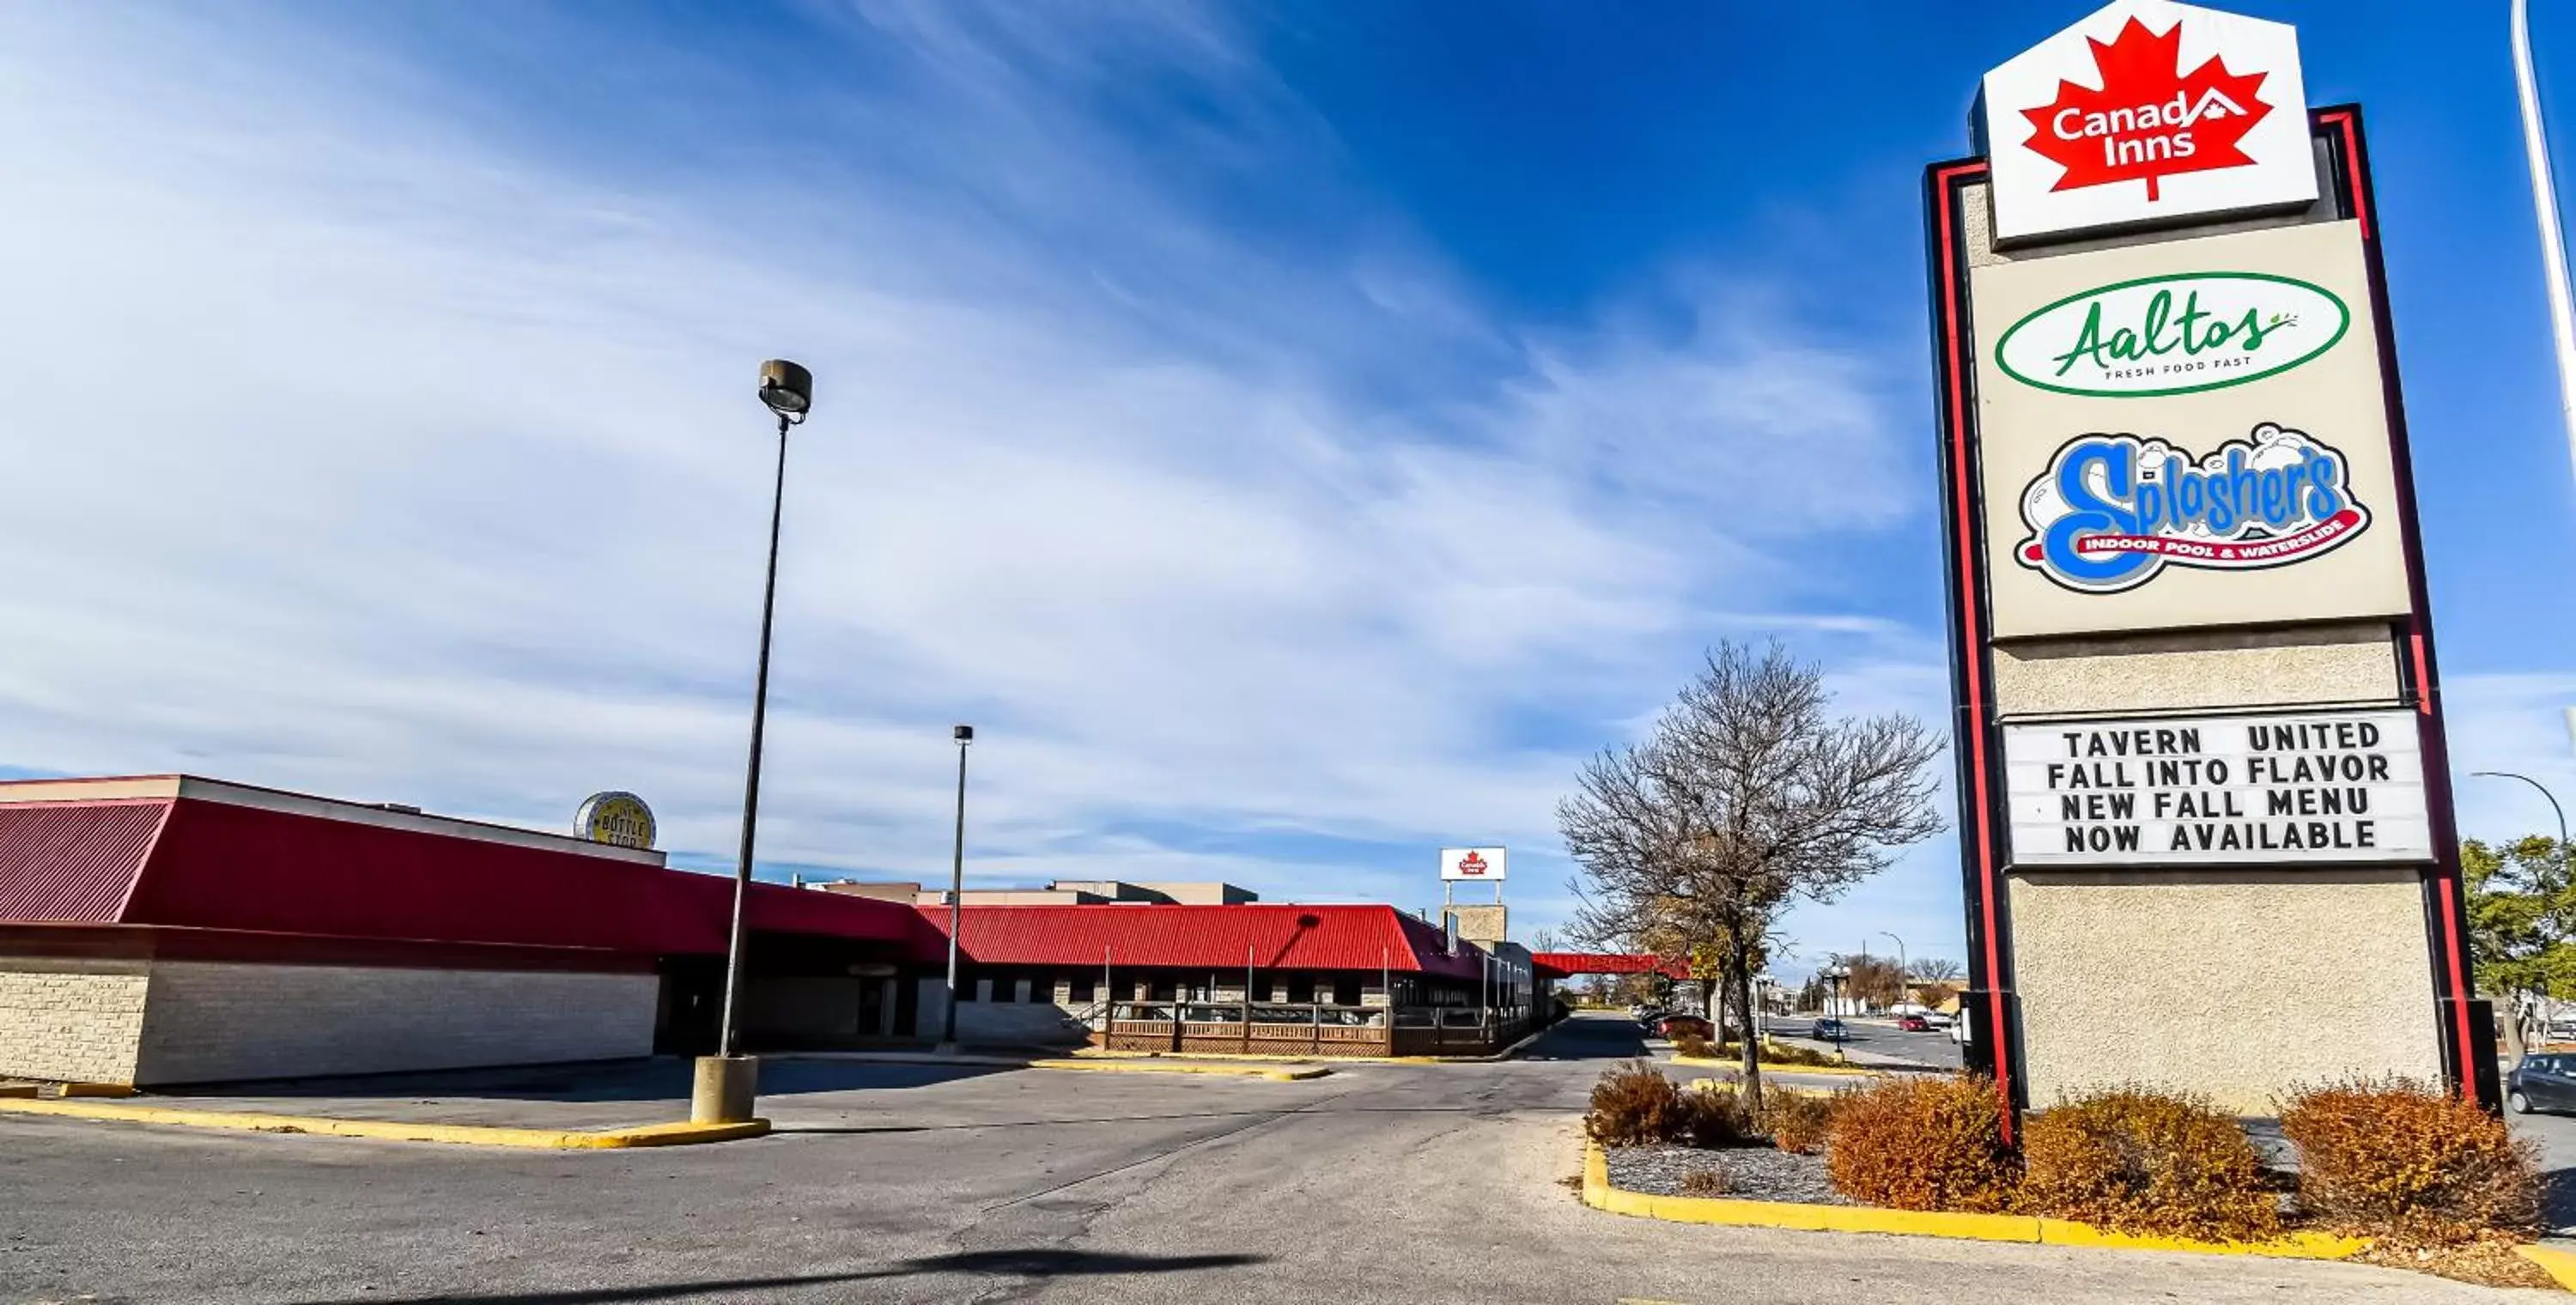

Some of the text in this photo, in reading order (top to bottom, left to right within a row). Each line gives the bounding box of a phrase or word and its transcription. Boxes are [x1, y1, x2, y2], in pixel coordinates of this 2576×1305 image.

[2105, 132, 2196, 167] Inns
[2053, 289, 2280, 376] Aaltos
[2105, 356, 2251, 379] FRESH FOOD FAST
[2043, 442, 2345, 584] Splasher's
[2086, 520, 2346, 558] INDOOR POOL & WATERSLIDE
[2063, 722, 2379, 758] TAVERN UNITED
[2048, 755, 2390, 789] FALL INTO FLAVOR
[2062, 787, 2368, 820] NEW FALL MENU
[2066, 820, 2375, 853] NOW AVAILABLE
